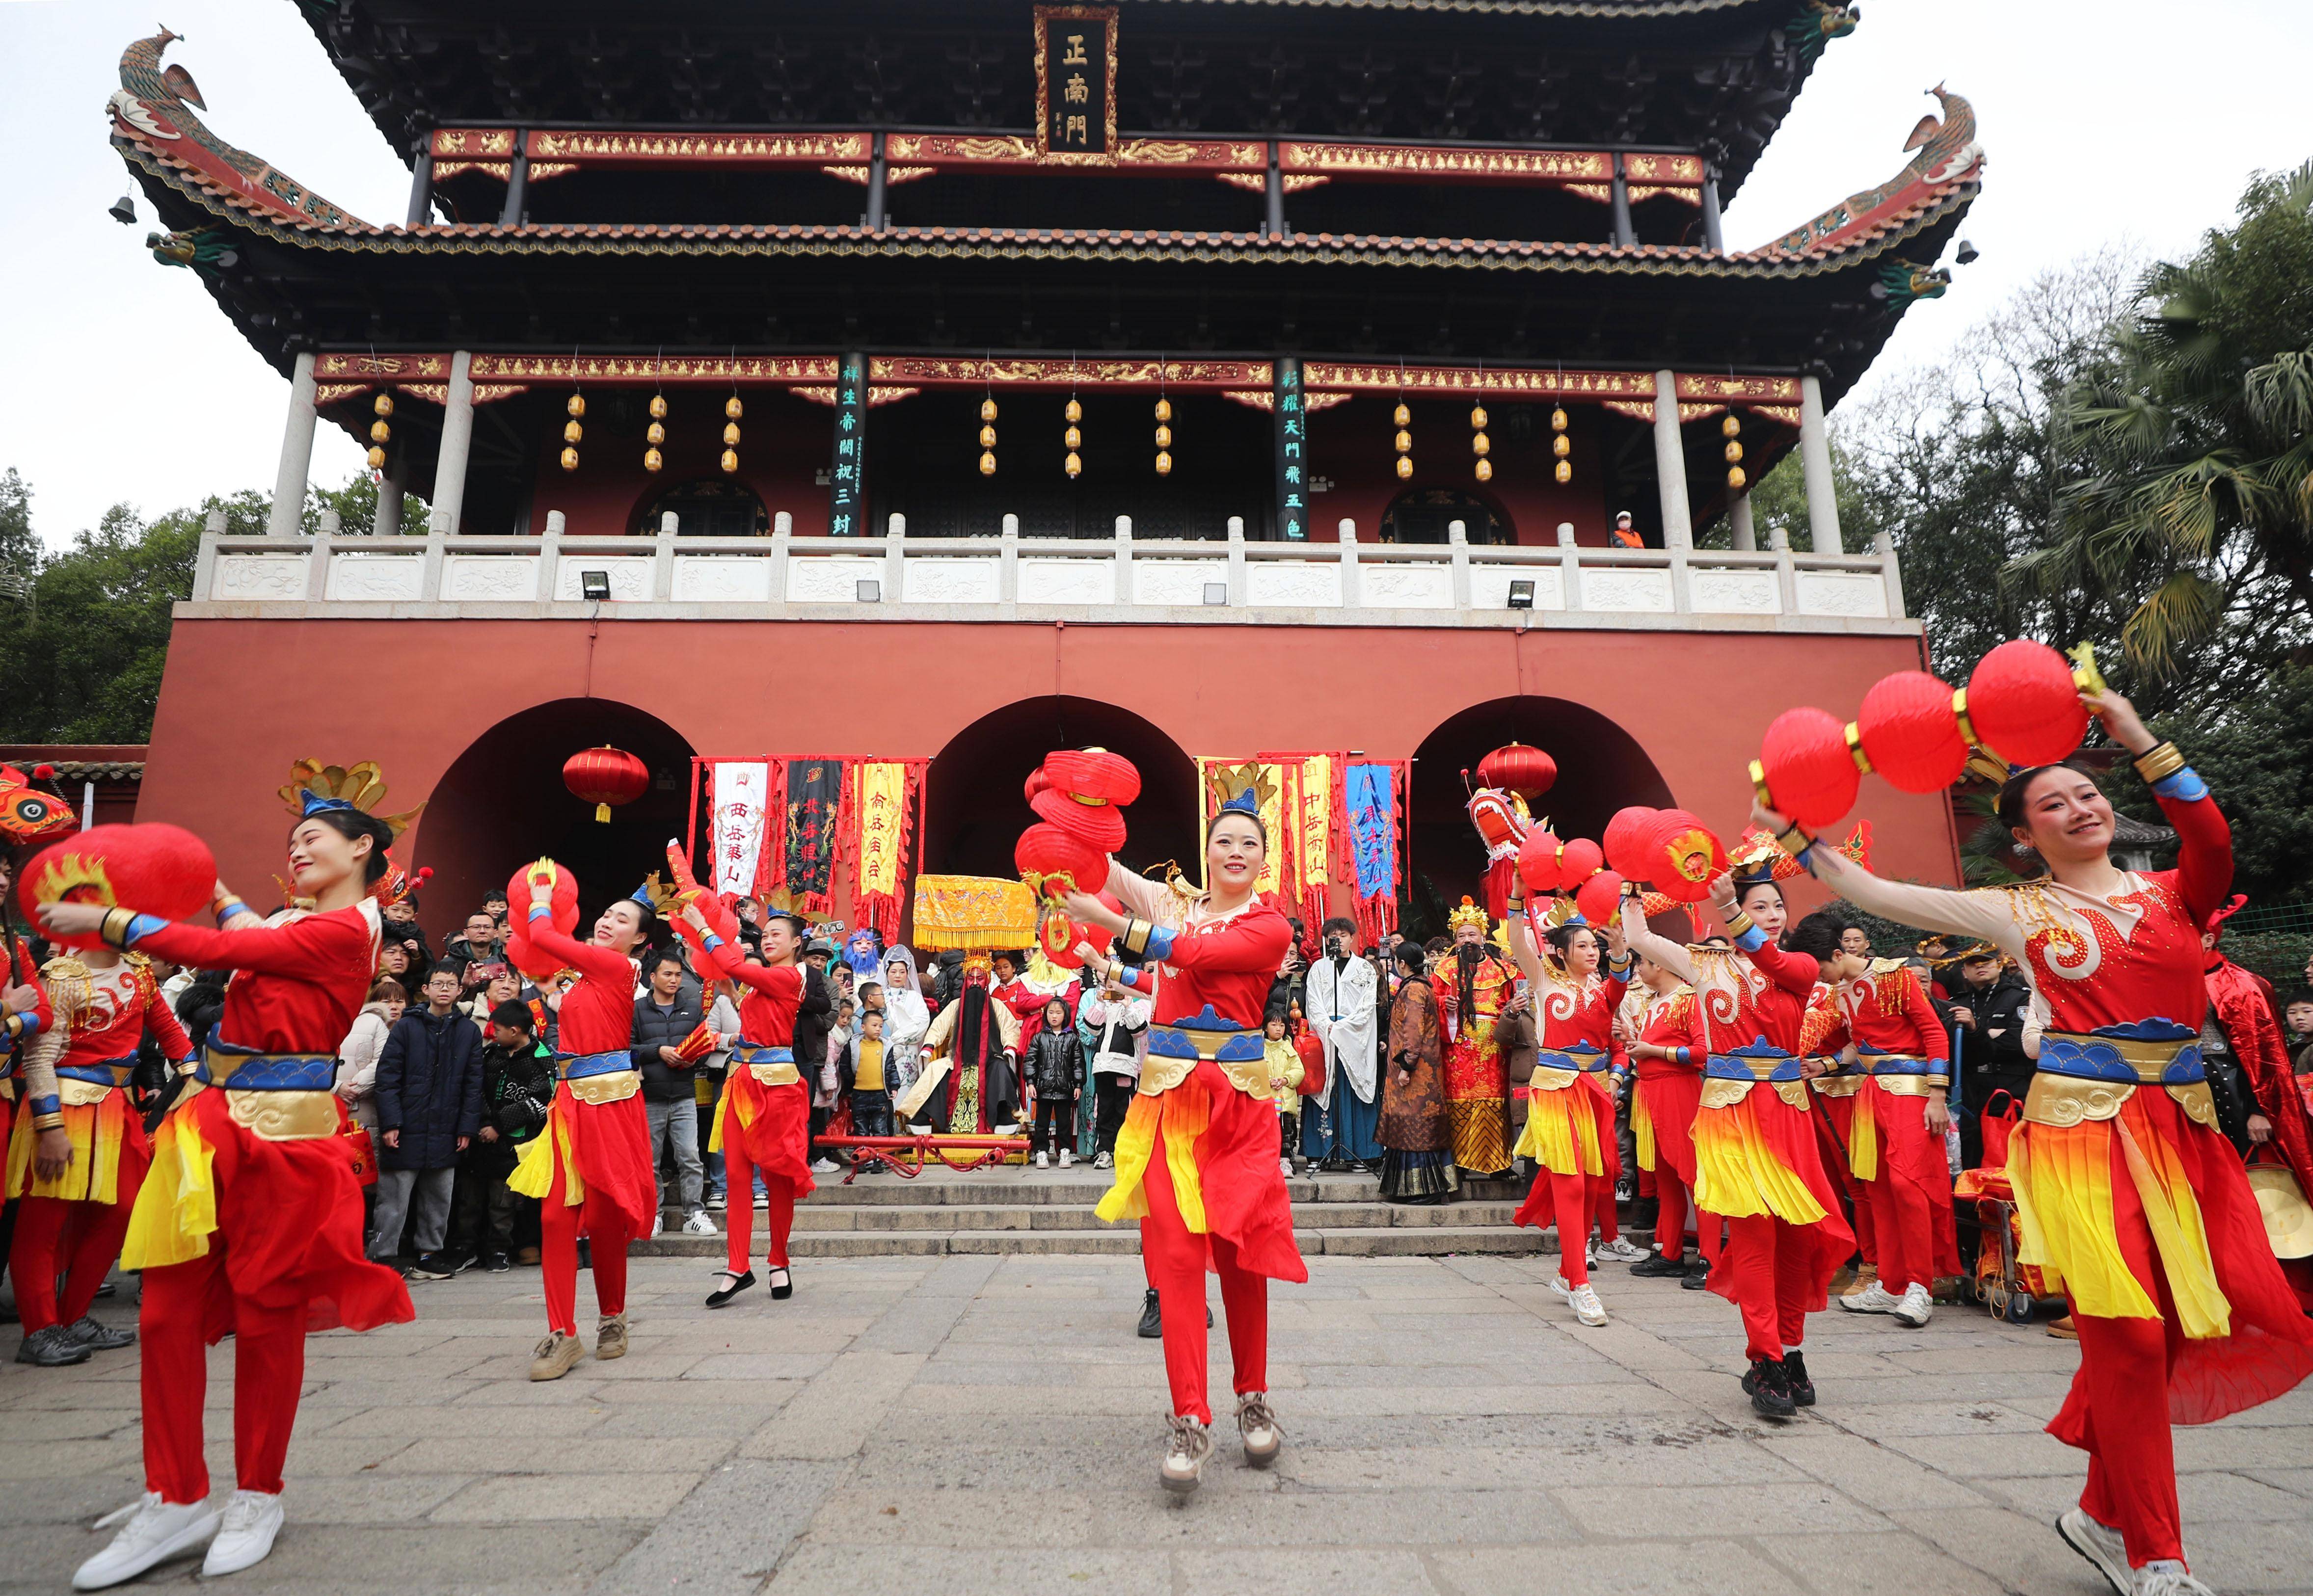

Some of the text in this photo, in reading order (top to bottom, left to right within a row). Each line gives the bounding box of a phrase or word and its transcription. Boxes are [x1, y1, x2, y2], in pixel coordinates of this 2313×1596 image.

[1062, 34, 1088, 145] 正南門
[1281, 370, 1304, 538] 彩耀天門飛五色
[725, 802, 749, 882] 西岳華山
[1303, 792, 1323, 874] 中岳嵩山
